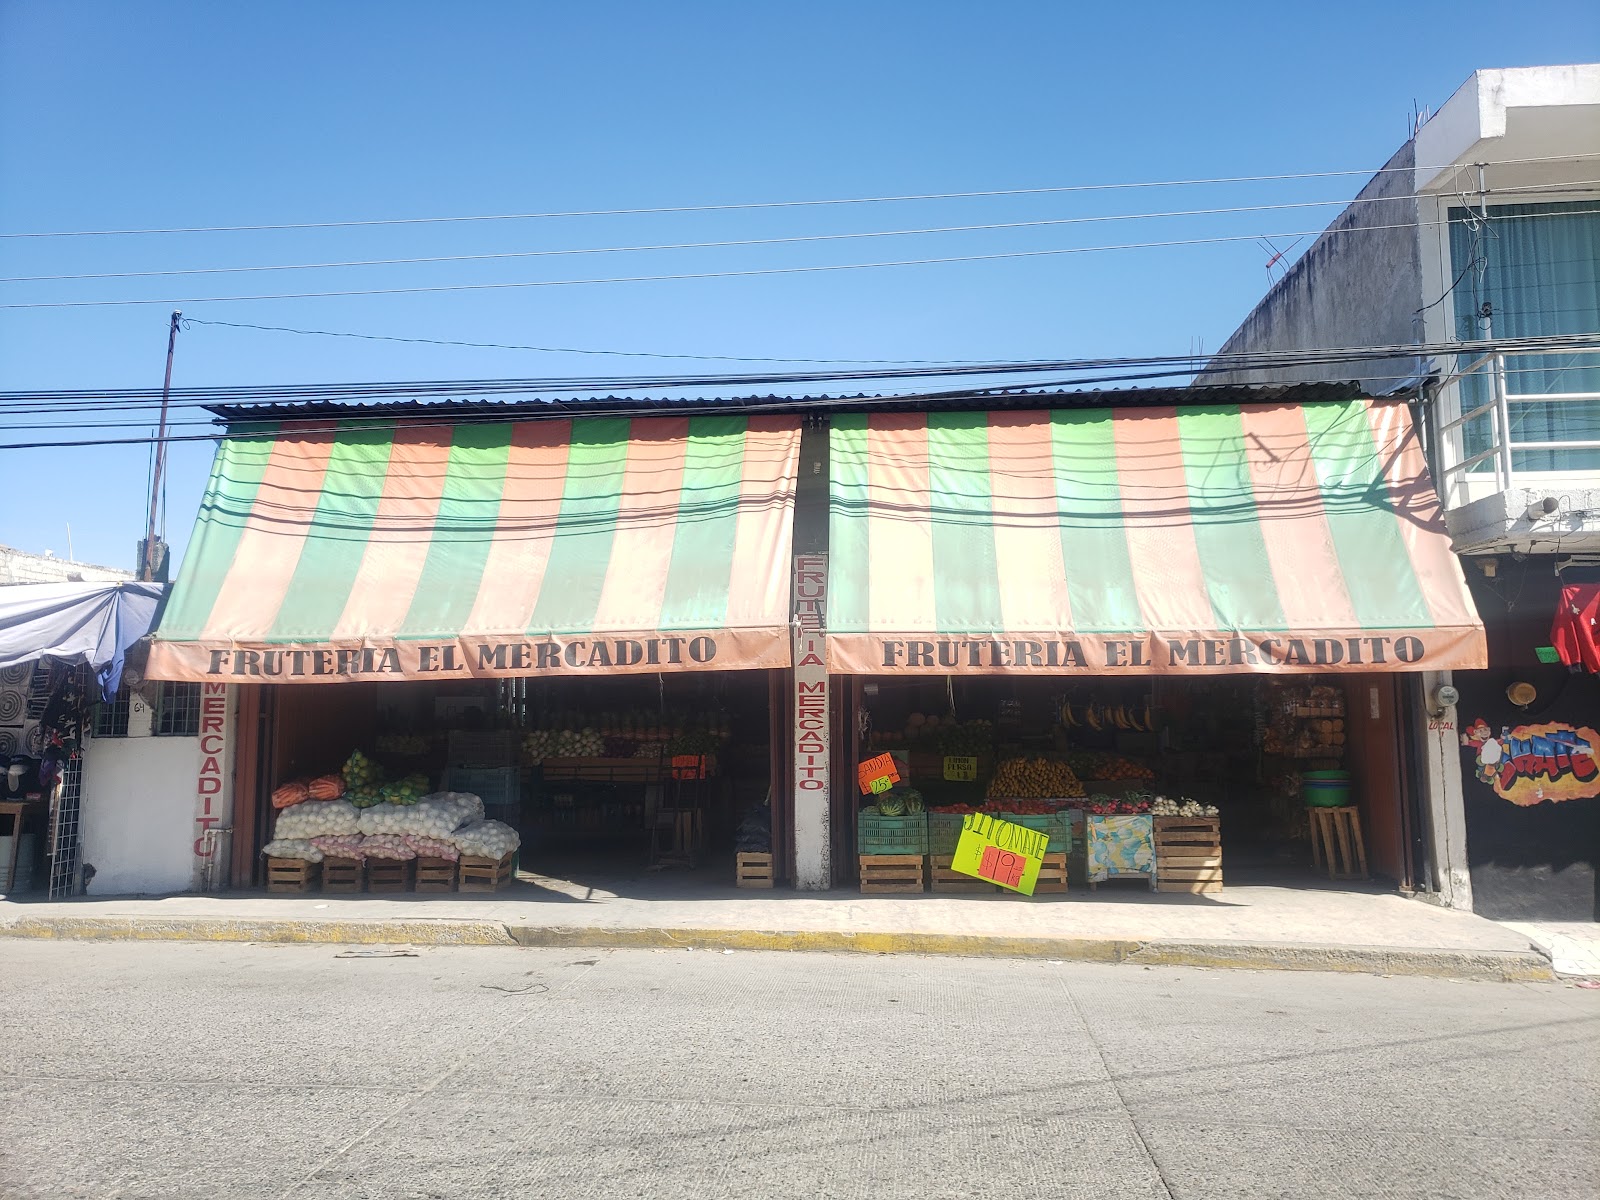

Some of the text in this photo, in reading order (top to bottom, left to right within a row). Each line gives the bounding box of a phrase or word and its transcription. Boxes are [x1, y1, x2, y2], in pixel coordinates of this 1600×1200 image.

[206, 636, 717, 676] FRUTERIA EL MERCADITO
[881, 635, 1425, 668] FRUTERIA EL MERCADITO
[133, 702, 145, 714] 64
[798, 681, 826, 791] MERCADITO
[193, 682, 226, 858] MERCADITO
